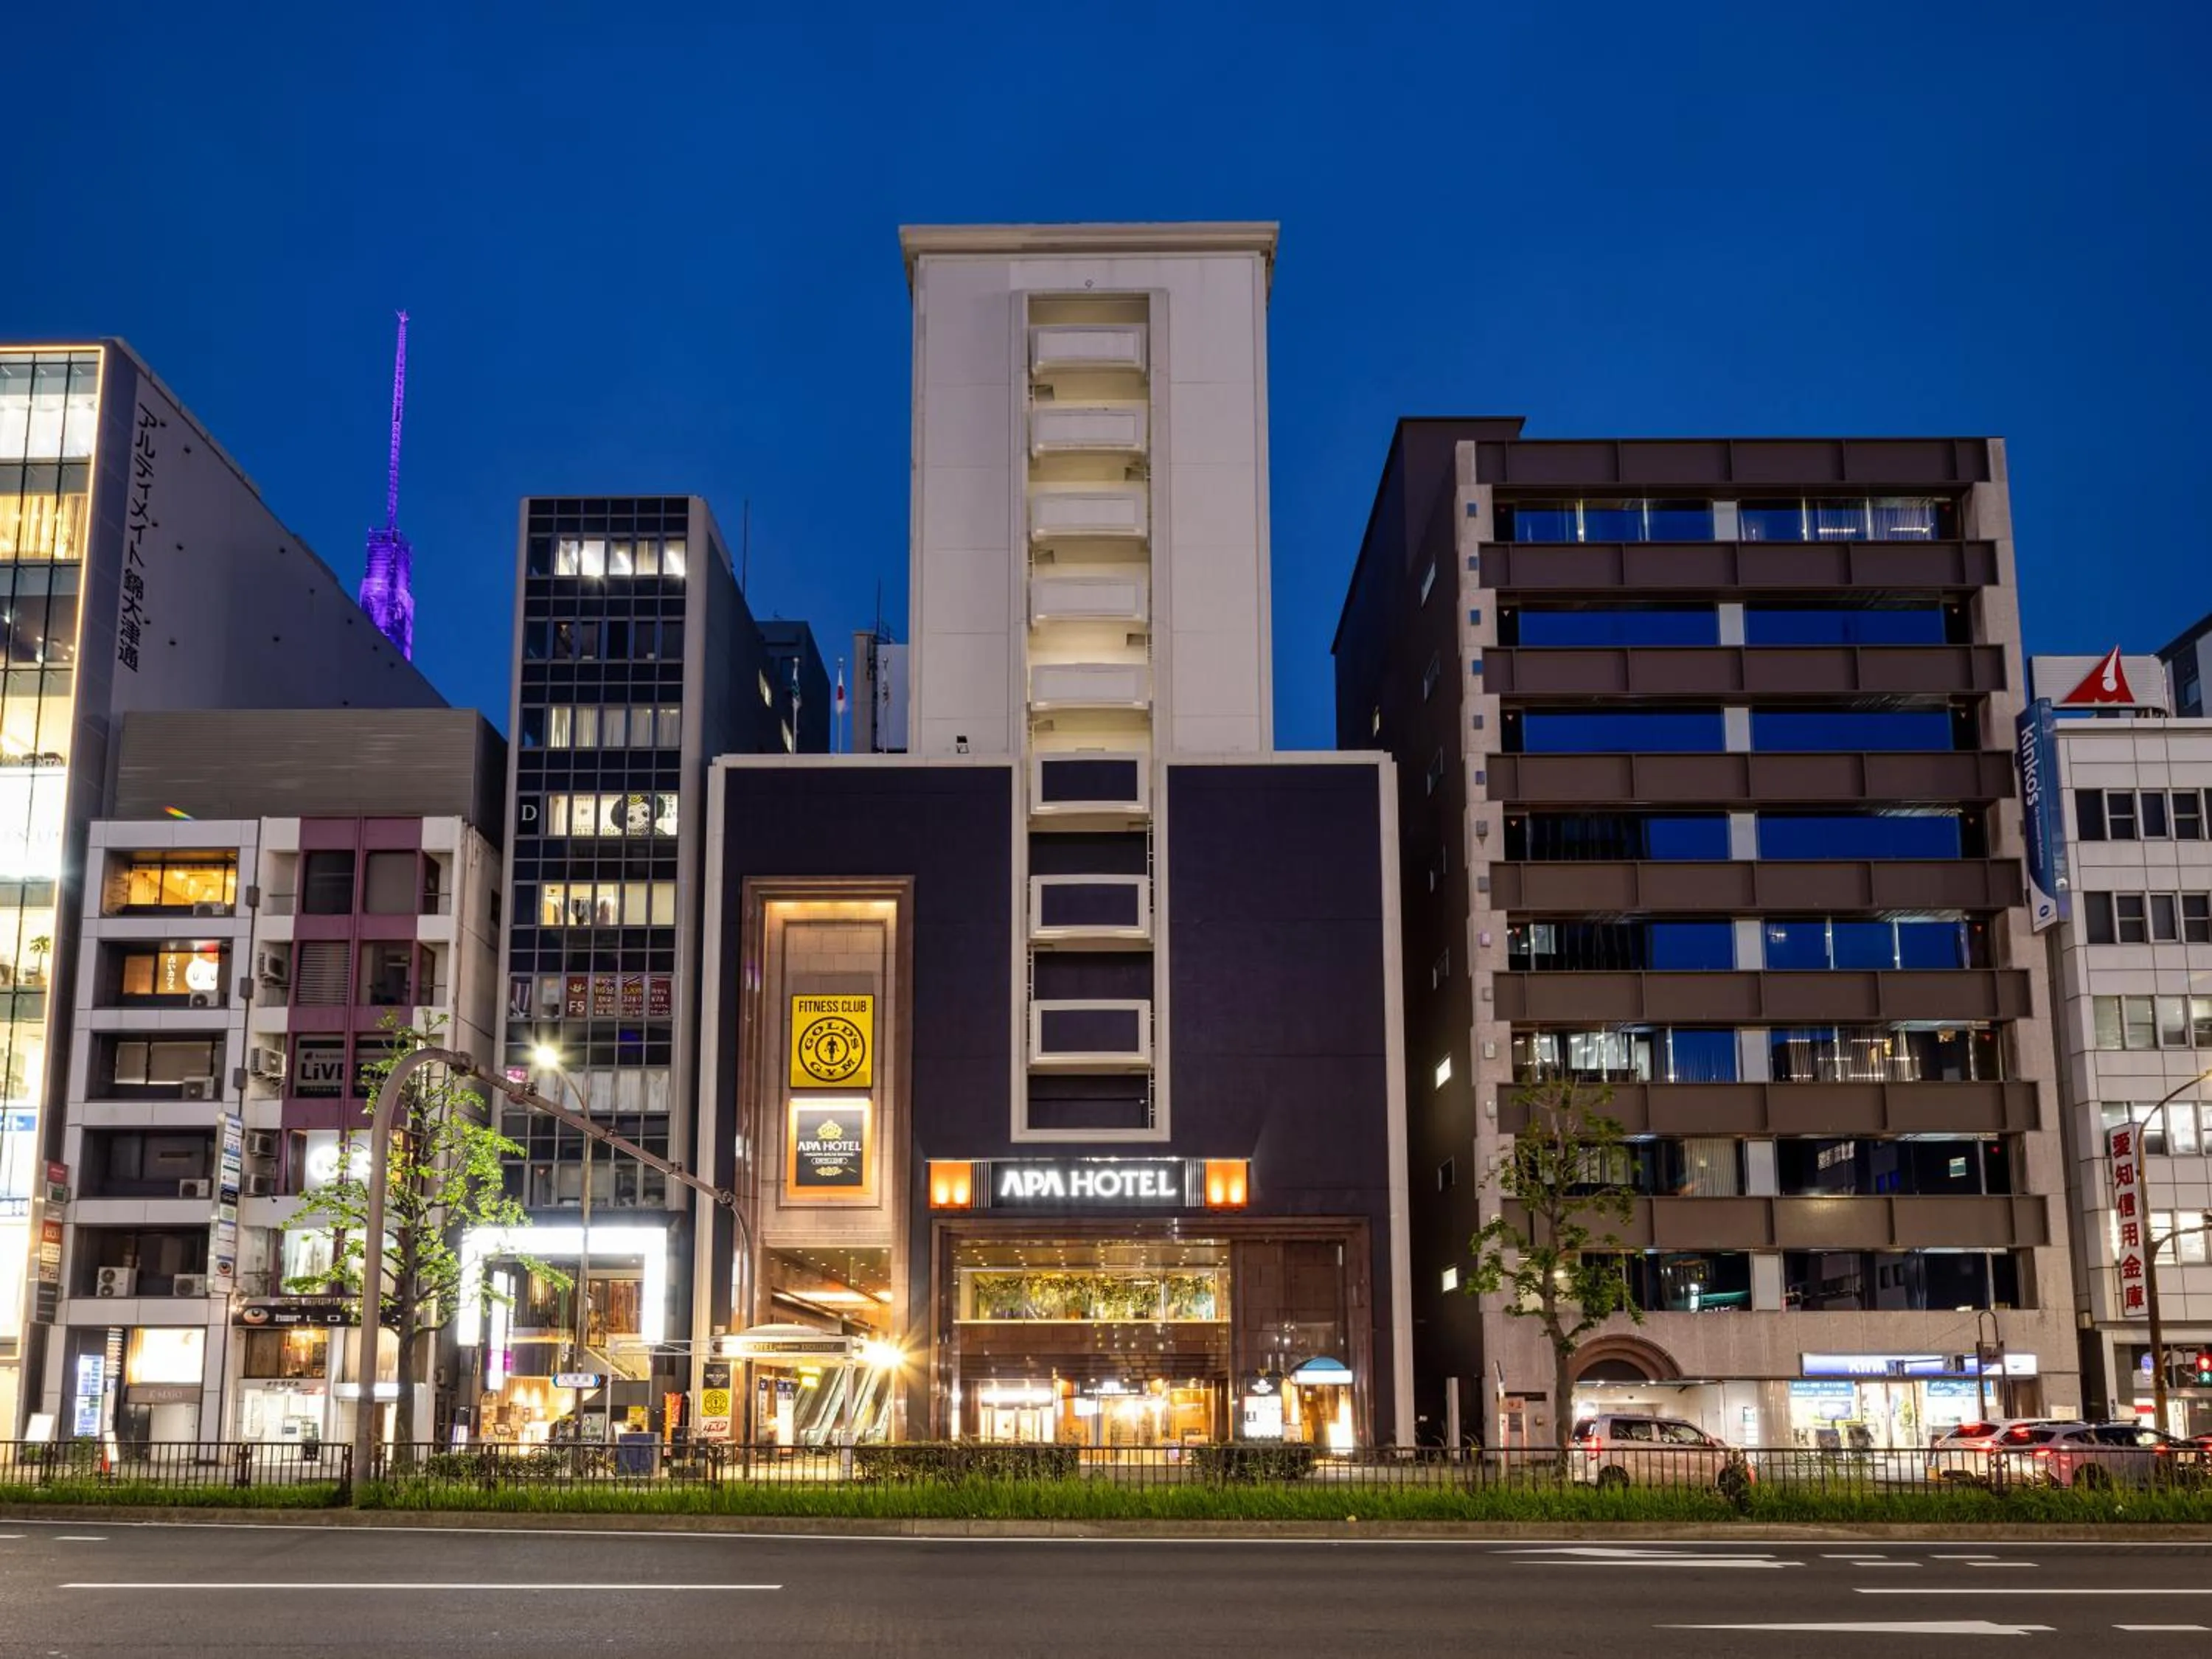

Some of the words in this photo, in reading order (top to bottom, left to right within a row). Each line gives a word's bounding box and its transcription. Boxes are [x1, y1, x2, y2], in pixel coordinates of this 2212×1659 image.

[2021, 721, 2042, 807] kinko's
[521, 804, 538, 821] D
[568, 1000, 585, 1012] F5
[799, 1000, 838, 1012] FITNESS
[841, 1000, 866, 1012] CLUB
[810, 1059, 855, 1077] GYM
[797, 1141, 821, 1152] APA
[823, 1141, 862, 1152] HOTEL
[1000, 1170, 1065, 1197] APA
[1071, 1169, 1178, 1197] HOTEL
[2112, 1131, 2144, 1310] 愛知信用金庫
